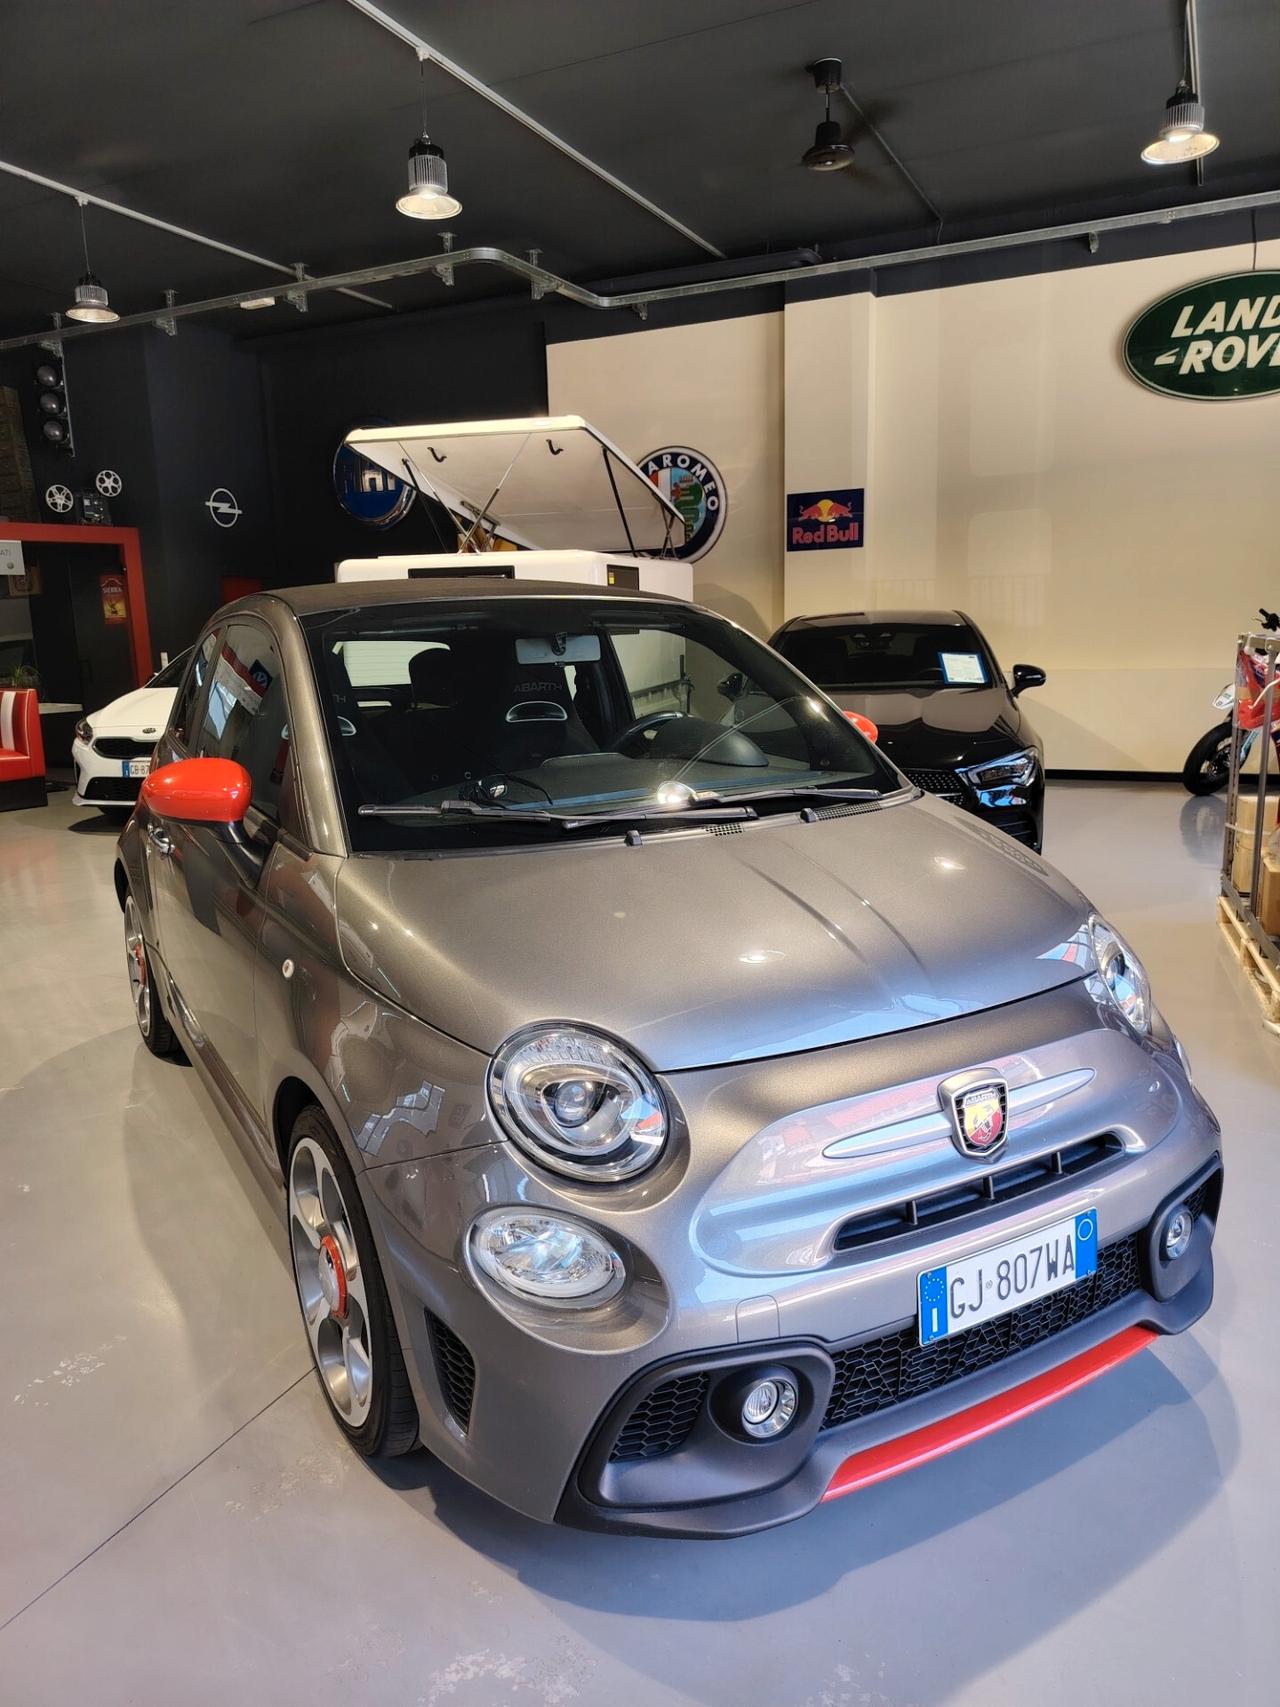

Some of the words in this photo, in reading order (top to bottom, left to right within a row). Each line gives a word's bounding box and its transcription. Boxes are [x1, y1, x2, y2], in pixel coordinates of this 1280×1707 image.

[1178, 333, 1280, 375] ROV
[792, 525, 825, 545] Red
[827, 522, 859, 542] Bull
[513, 681, 563, 693] ABARTH
